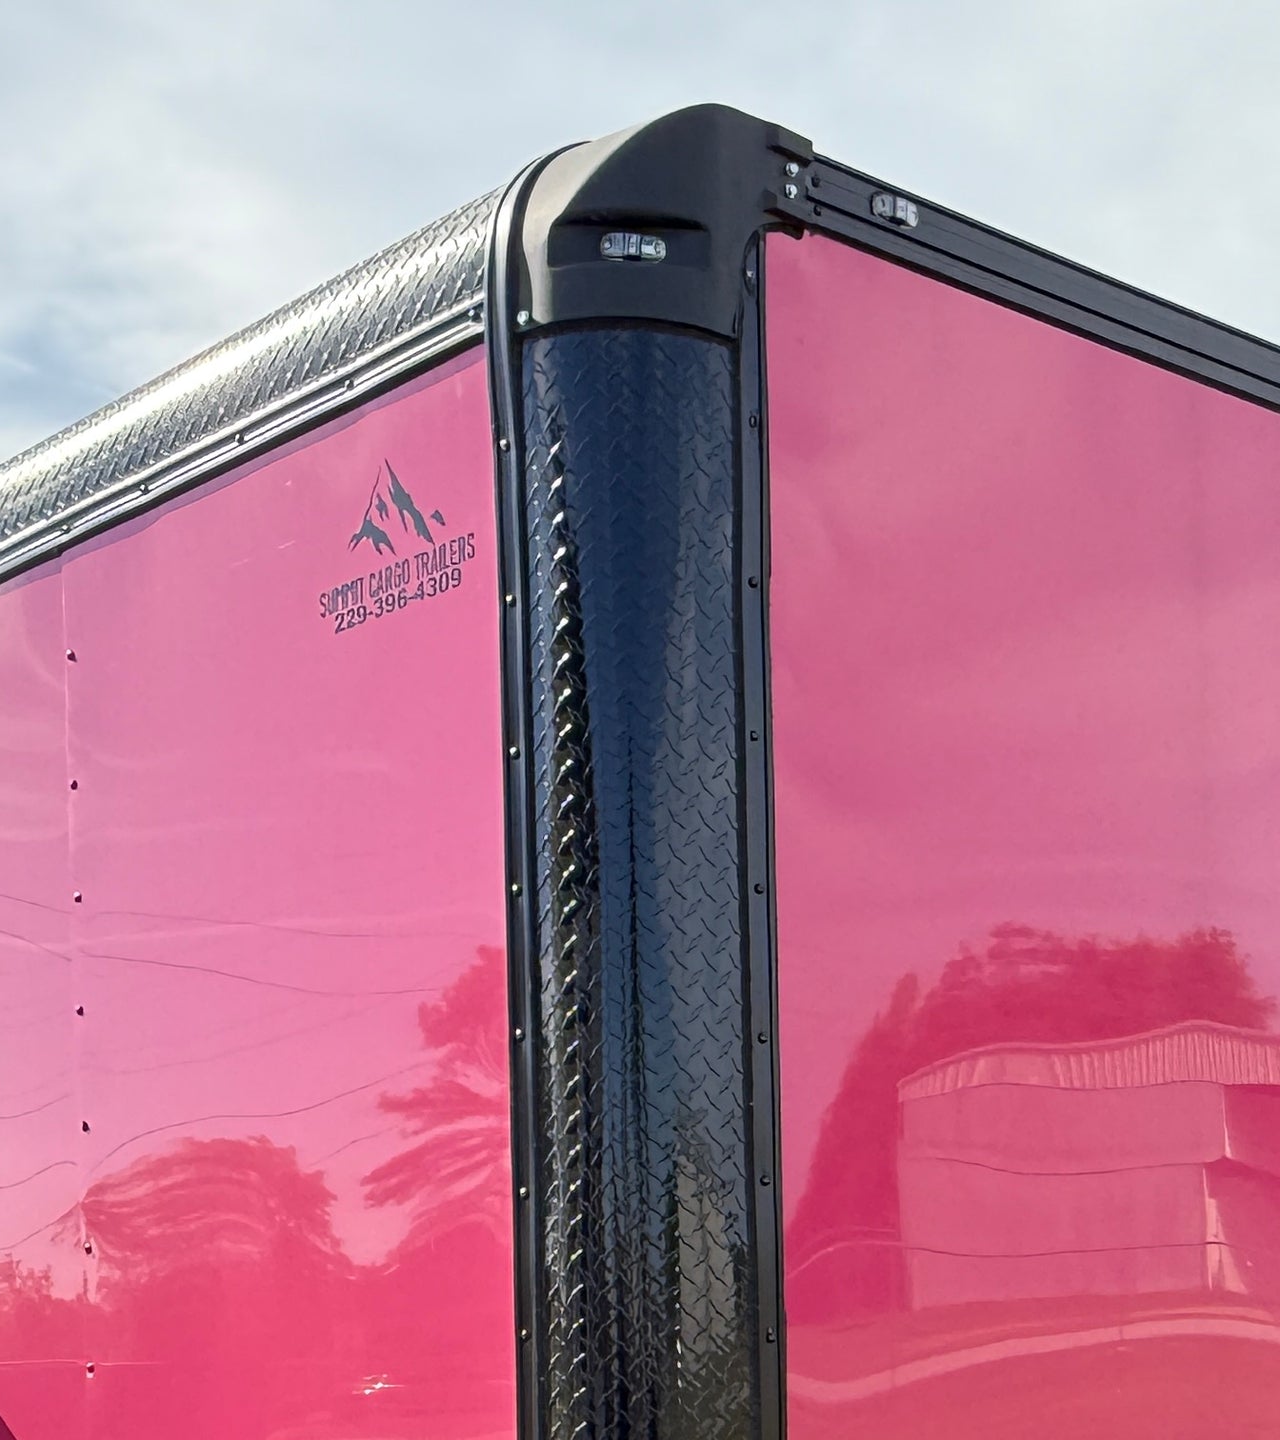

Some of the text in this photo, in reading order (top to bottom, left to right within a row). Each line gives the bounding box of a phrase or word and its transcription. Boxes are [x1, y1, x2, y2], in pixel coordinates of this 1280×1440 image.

[320, 533, 476, 618] SUMMIT CARGO TRAILERS
[334, 568, 462, 634] 229-396-4309
